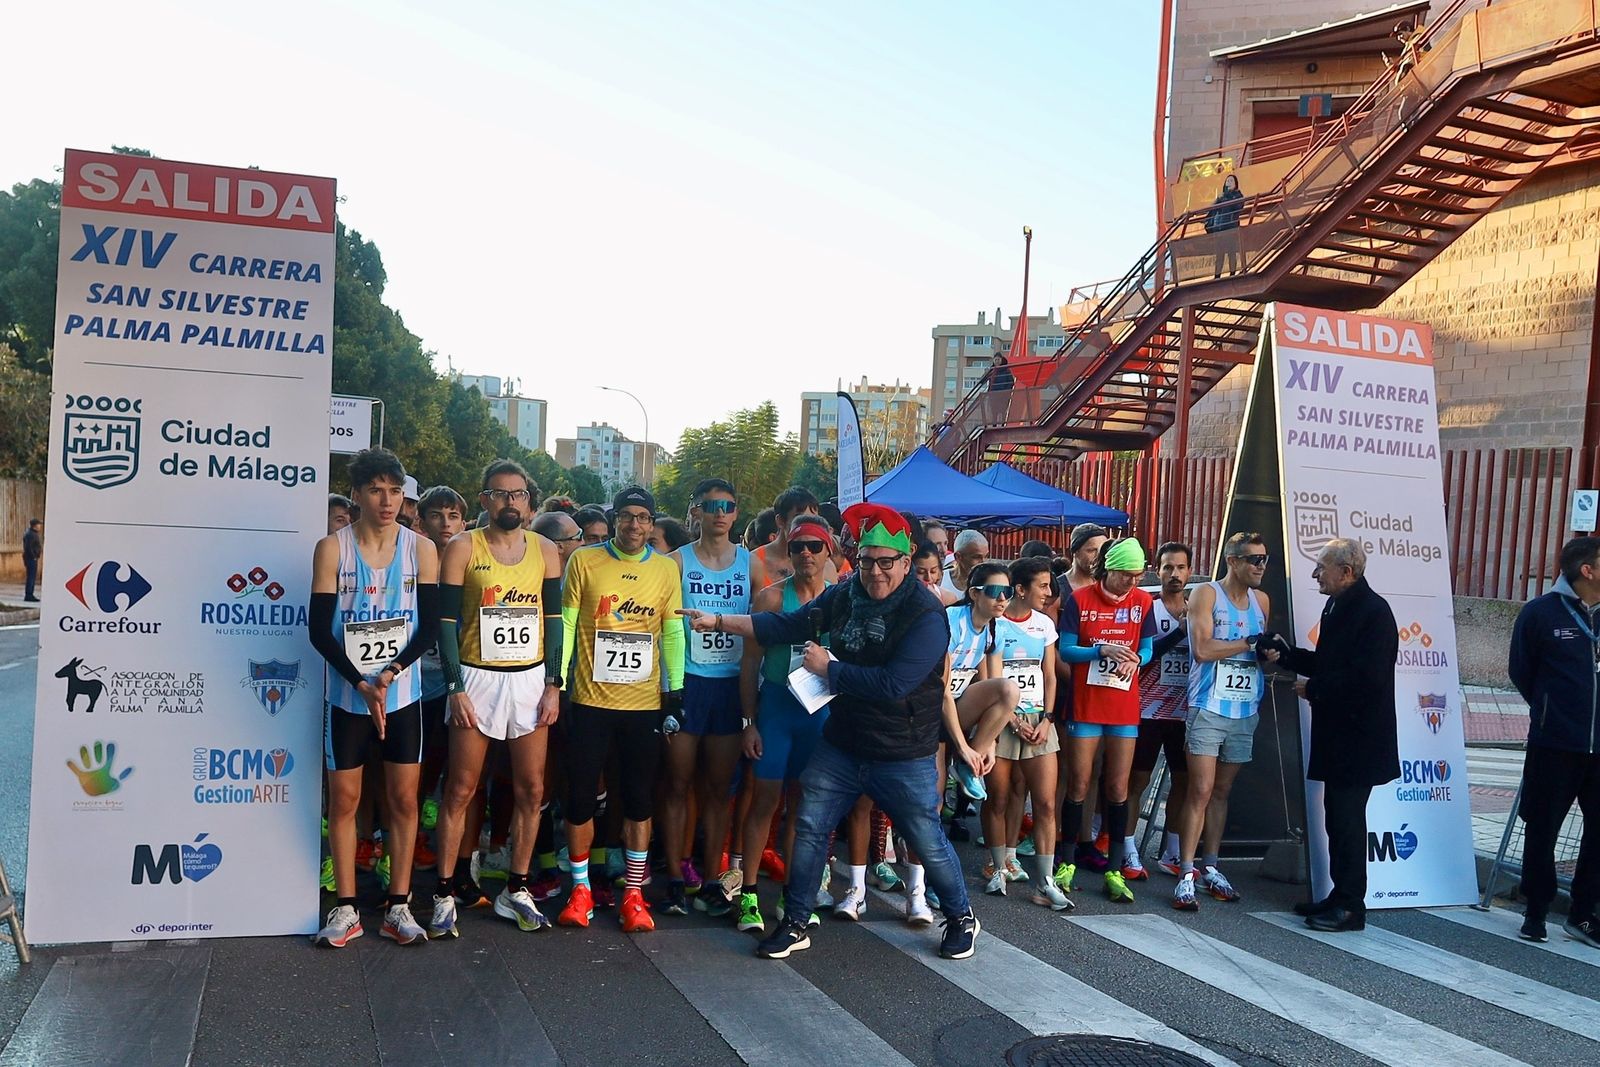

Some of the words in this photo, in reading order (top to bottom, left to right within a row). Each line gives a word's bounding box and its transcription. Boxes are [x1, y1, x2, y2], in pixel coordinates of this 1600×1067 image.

[78, 162, 322, 224] SALIDA
[70, 223, 178, 269] XIV
[189, 252, 322, 283] CARRERA
[86, 282, 151, 308] SAN
[158, 288, 309, 321] SILVESTRE
[63, 314, 171, 343] PALMA
[180, 324, 325, 354] PALMILLA
[1284, 311, 1425, 359] SALIDA
[1285, 359, 1344, 394] XIV
[1352, 381, 1429, 405] CARRERA
[1297, 404, 1333, 424] SAN
[1338, 410, 1424, 434] SILVESTRE
[160, 419, 271, 449] Ciudad
[1287, 429, 1348, 451] PALMA
[1353, 436, 1437, 460] PALMILLA
[159, 453, 199, 477] de
[208, 455, 317, 487] Málaga
[1349, 510, 1413, 532] Ciudad
[1360, 536, 1374, 554] e
[1379, 537, 1442, 563] Málaga
[503, 586, 538, 603] Álora
[689, 579, 744, 599] nerja
[617, 597, 655, 617] Álora
[697, 600, 737, 608] ATLETISMO
[59, 615, 162, 634] Carrefour
[201, 602, 309, 627] ROSALEDA
[215, 628, 260, 636] NUESTRO
[262, 629, 293, 637] LUGAR
[493, 627, 530, 645] 616
[702, 632, 734, 649] 565
[359, 639, 399, 661] 225
[606, 650, 642, 669] 715
[1396, 650, 1448, 668] OSALEDA
[111, 671, 176, 680] ASOCIACION
[189, 672, 205, 681] DE
[1164, 660, 1190, 674] 236
[1225, 674, 1252, 690] 122
[142, 689, 205, 697] COMUNIDAD
[109, 705, 143, 713] PALMA
[157, 705, 204, 713] PALMILLA
[193, 747, 208, 781] GRUPO
[208, 748, 263, 780] BCM
[1402, 760, 1434, 784] BCM
[193, 784, 289, 804] GestionARTE
[1396, 786, 1451, 802] GestionARTE
[183, 852, 207, 860] Málaga
[1387, 890, 1419, 899] deporinter
[158, 923, 214, 933] deporinter
